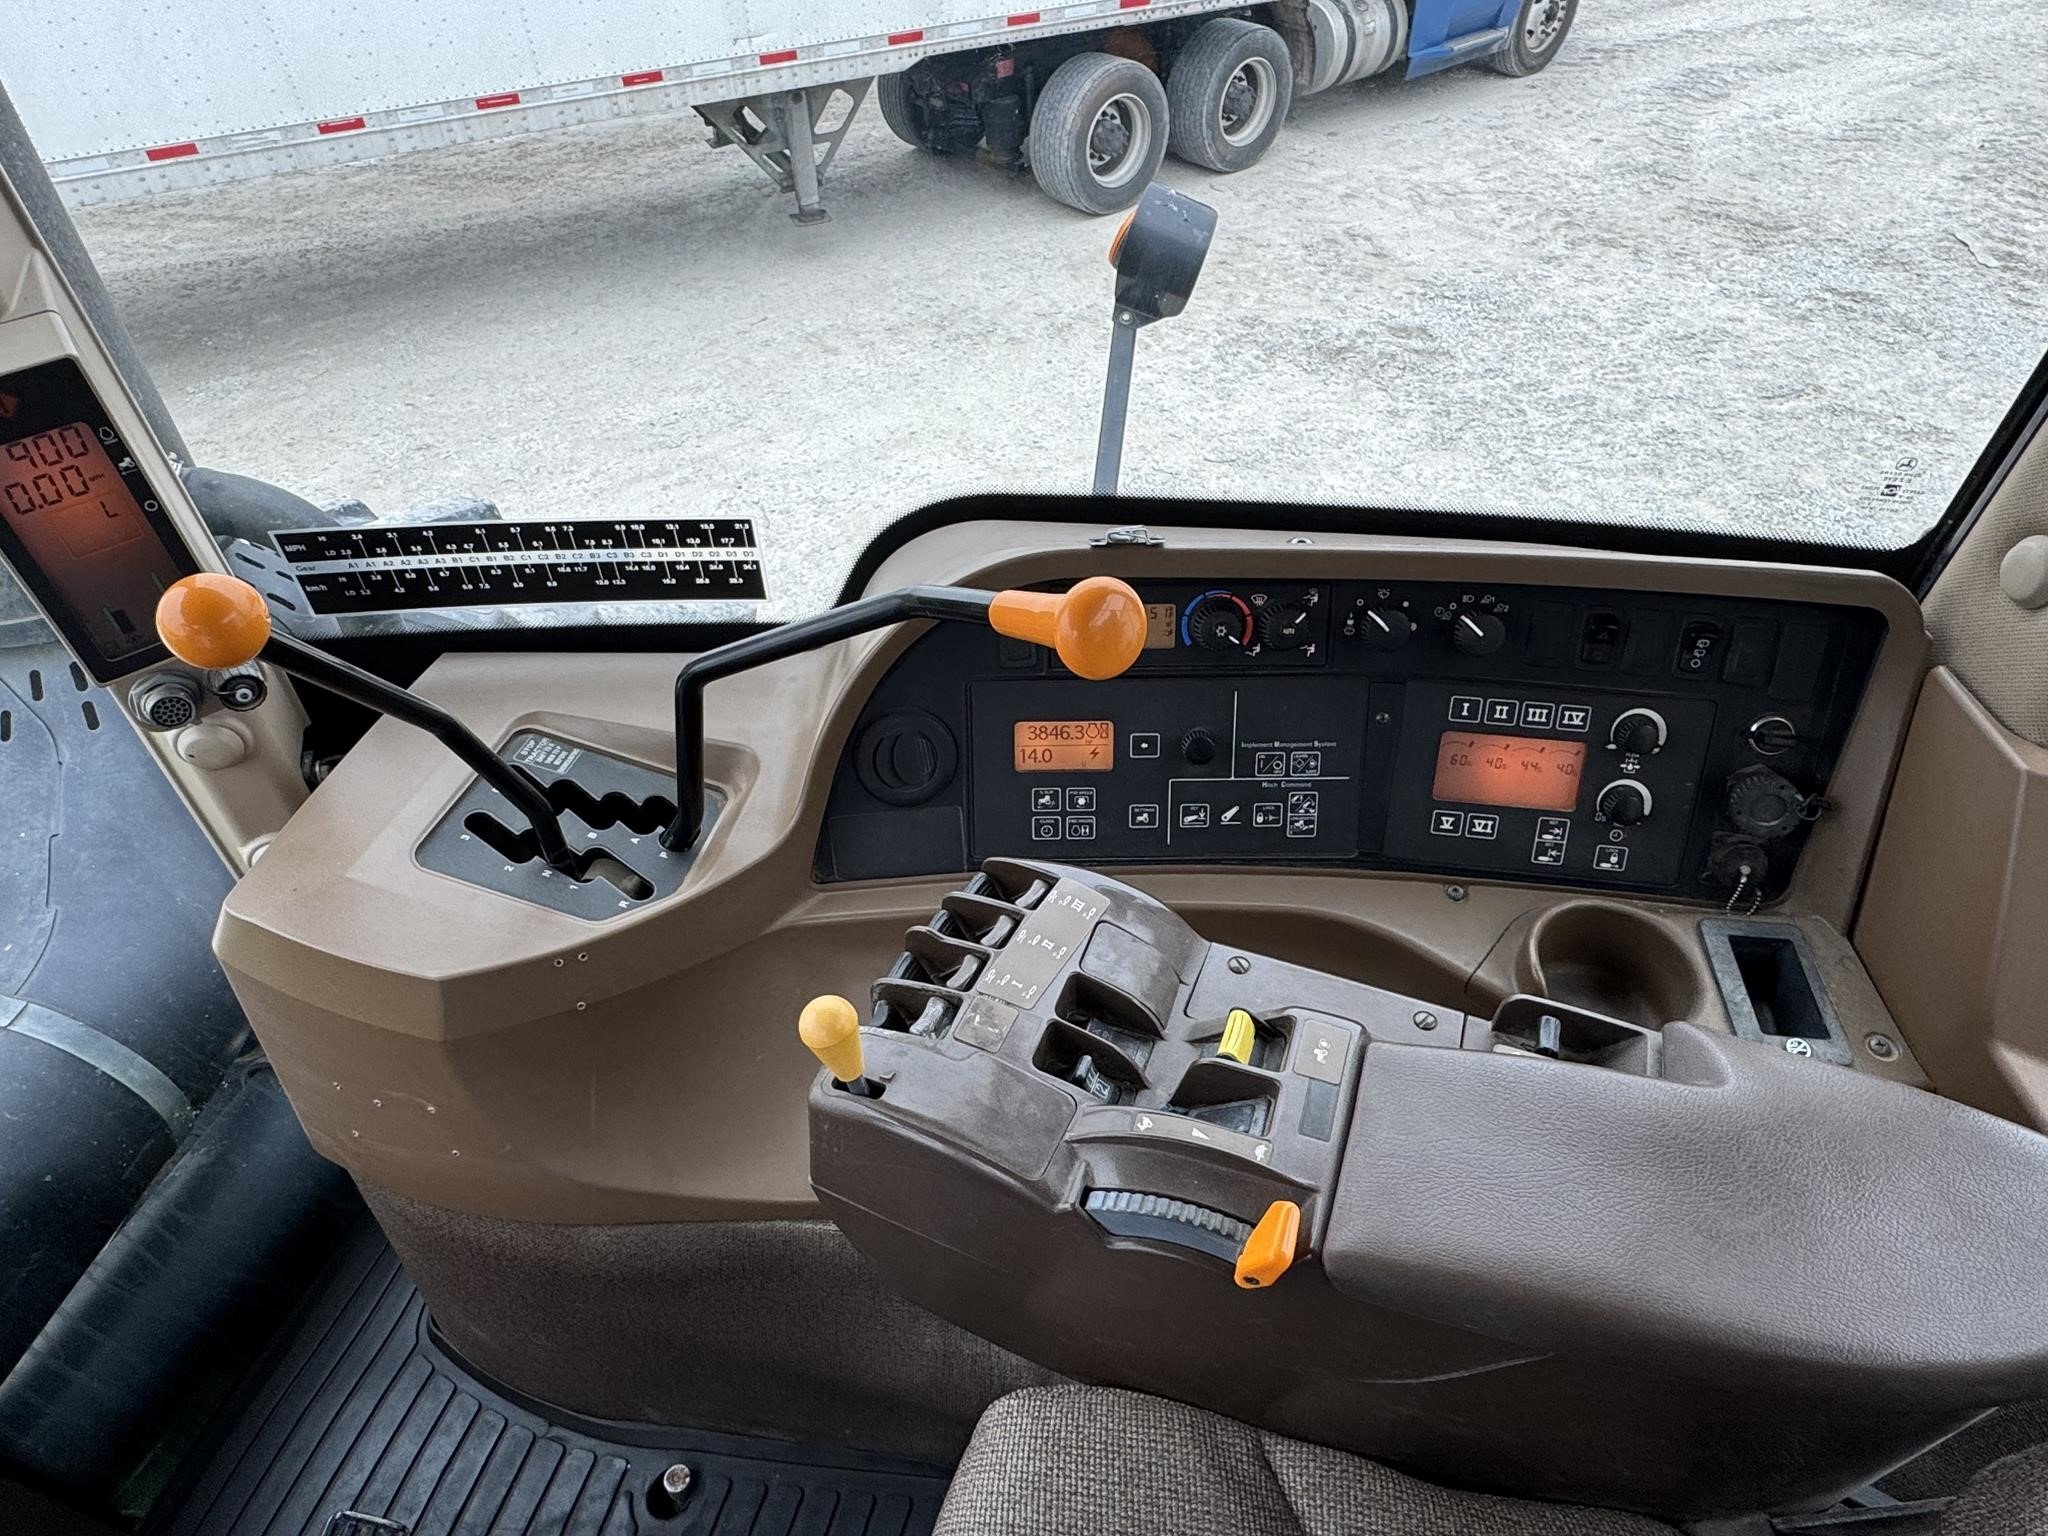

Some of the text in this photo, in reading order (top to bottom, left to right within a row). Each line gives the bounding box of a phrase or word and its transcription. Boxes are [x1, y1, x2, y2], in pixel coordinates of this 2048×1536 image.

[6, 426, 89, 468] 900
[4, 465, 90, 515] 0.00
[284, 544, 306, 552] MPH
[305, 584, 328, 592] km/h
[1462, 702, 1471, 716] I
[1494, 706, 1509, 719] II
[1526, 708, 1549, 722] III
[1562, 710, 1586, 725] IV
[1027, 725, 1085, 740] 3846.3
[520, 738, 536, 756] STOP
[1020, 748, 1053, 764] 14.0
[1438, 816, 1455, 830] V
[1471, 819, 1494, 833] VI
[659, 851, 669, 859] P
[618, 900, 630, 908] R
